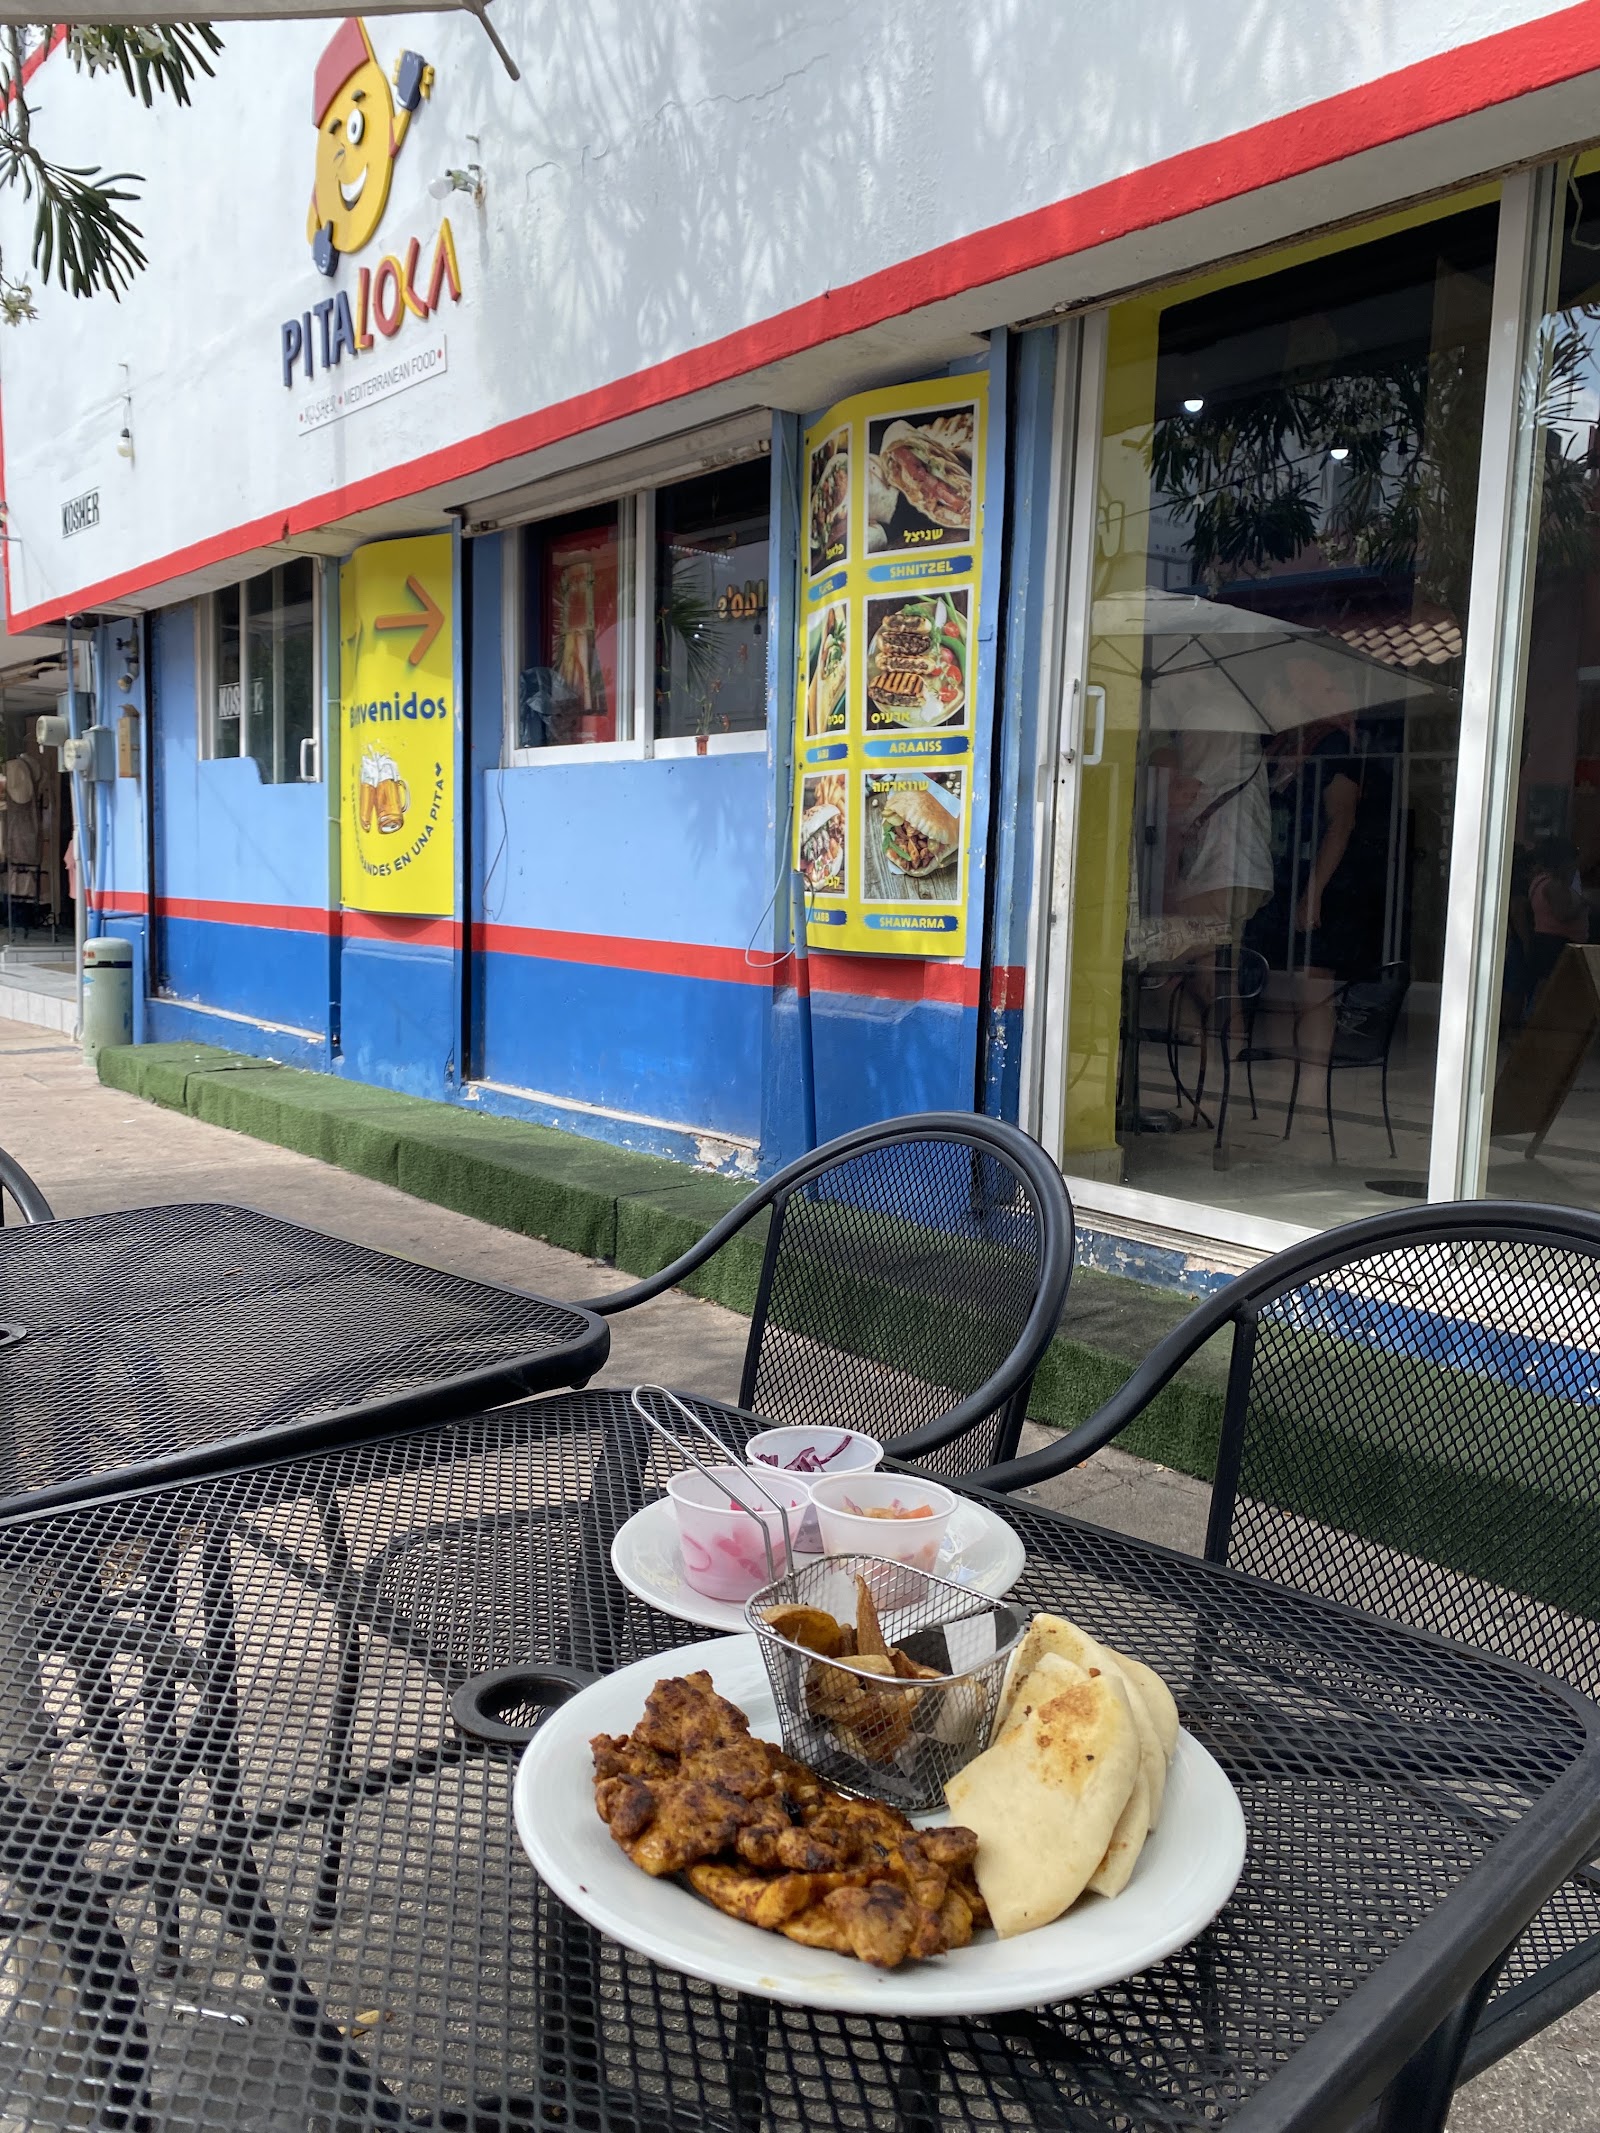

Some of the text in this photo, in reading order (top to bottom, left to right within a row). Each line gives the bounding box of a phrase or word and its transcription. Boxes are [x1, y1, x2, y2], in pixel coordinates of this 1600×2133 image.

[343, 360, 411, 405] MEDITERRANEAN
[411, 349, 436, 376] FOOD
[62, 492, 100, 536] KOSHER
[903, 528, 944, 544] שניצל
[889, 560, 954, 578] SHNITZEL
[218, 681, 264, 717] KOSR
[349, 691, 447, 729] Bvenidos
[889, 740, 943, 753] ARAAISS
[359, 779, 445, 877] ANDES EN UNA PITA
[879, 916, 946, 929] SHAWARMA
